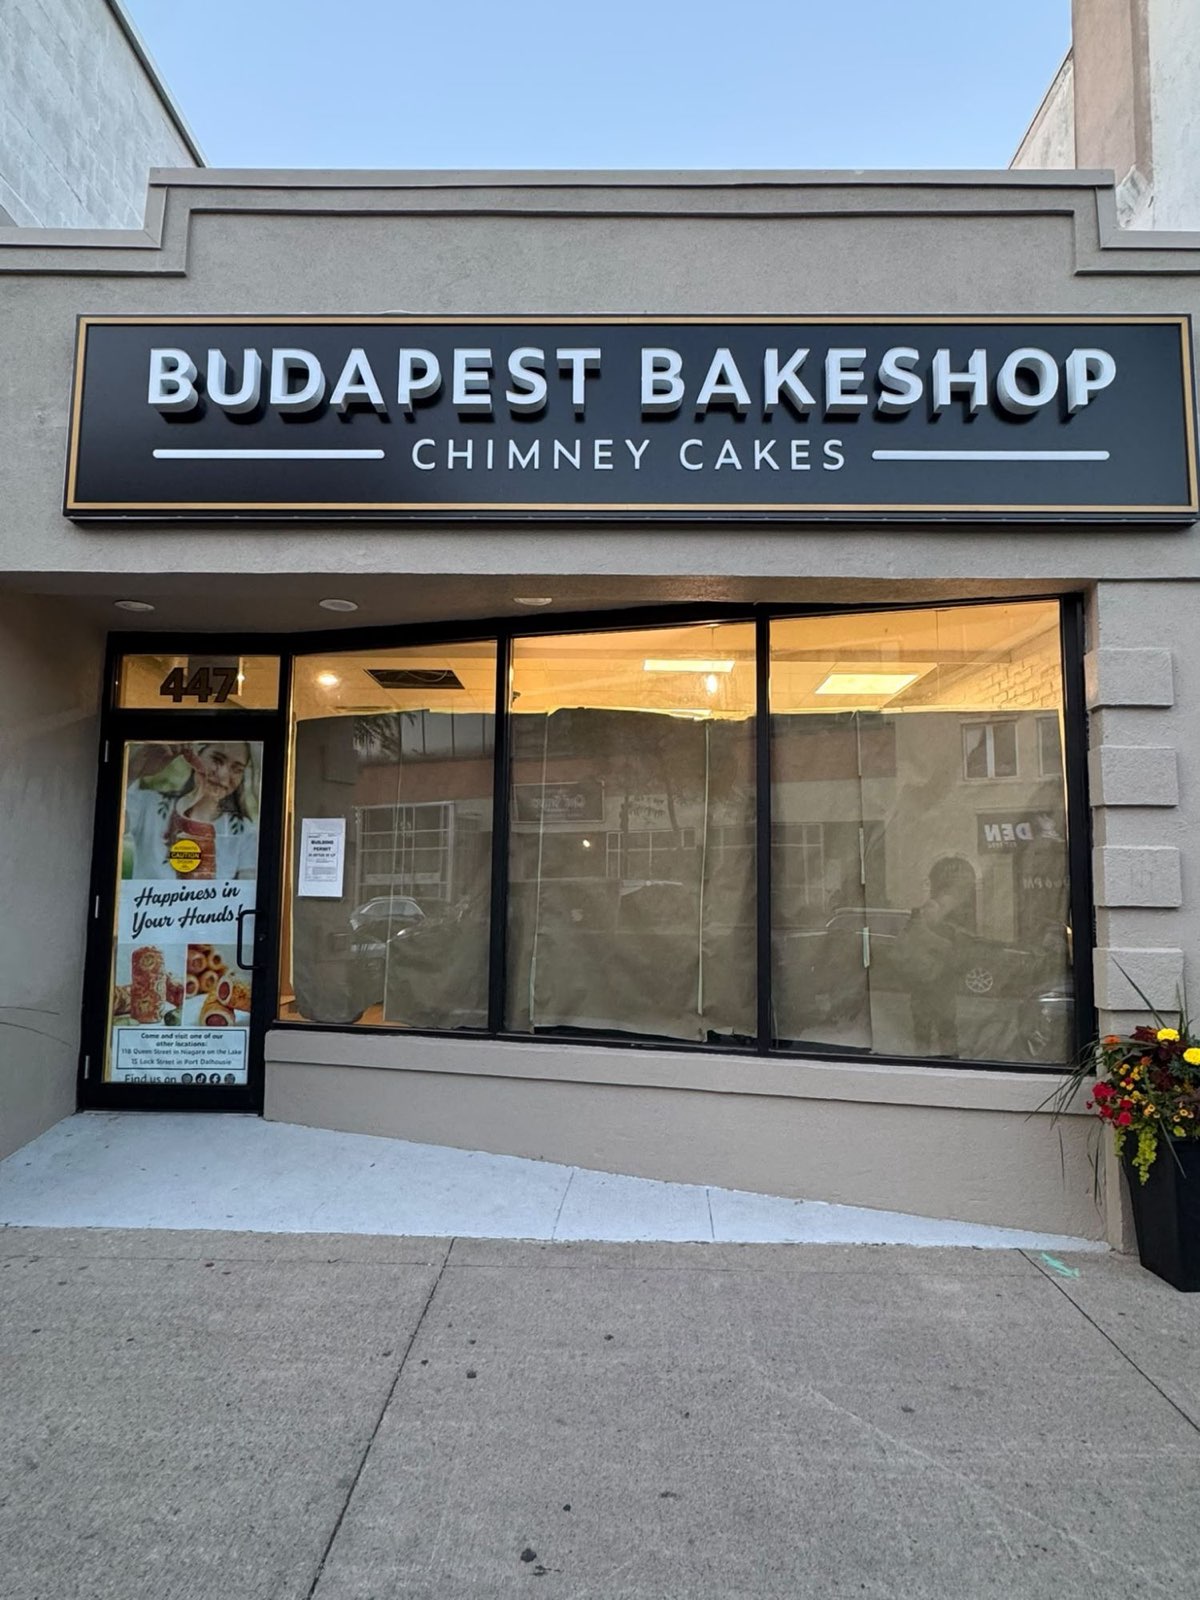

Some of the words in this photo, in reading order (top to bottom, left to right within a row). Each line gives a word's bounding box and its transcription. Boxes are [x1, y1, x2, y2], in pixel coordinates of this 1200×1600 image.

[147, 347, 602, 413] BUDAPEST
[640, 347, 1118, 414] BAKESHOP
[411, 438, 651, 471] CHIMNEY
[679, 438, 846, 471] CAKES
[159, 667, 240, 703] 447
[134, 885, 217, 909] Happiness
[222, 881, 241, 898] in
[131, 911, 174, 939] Your
[178, 904, 243, 928] Hands!
[124, 1073, 148, 1083] Find
[149, 1075, 161, 1083] us
